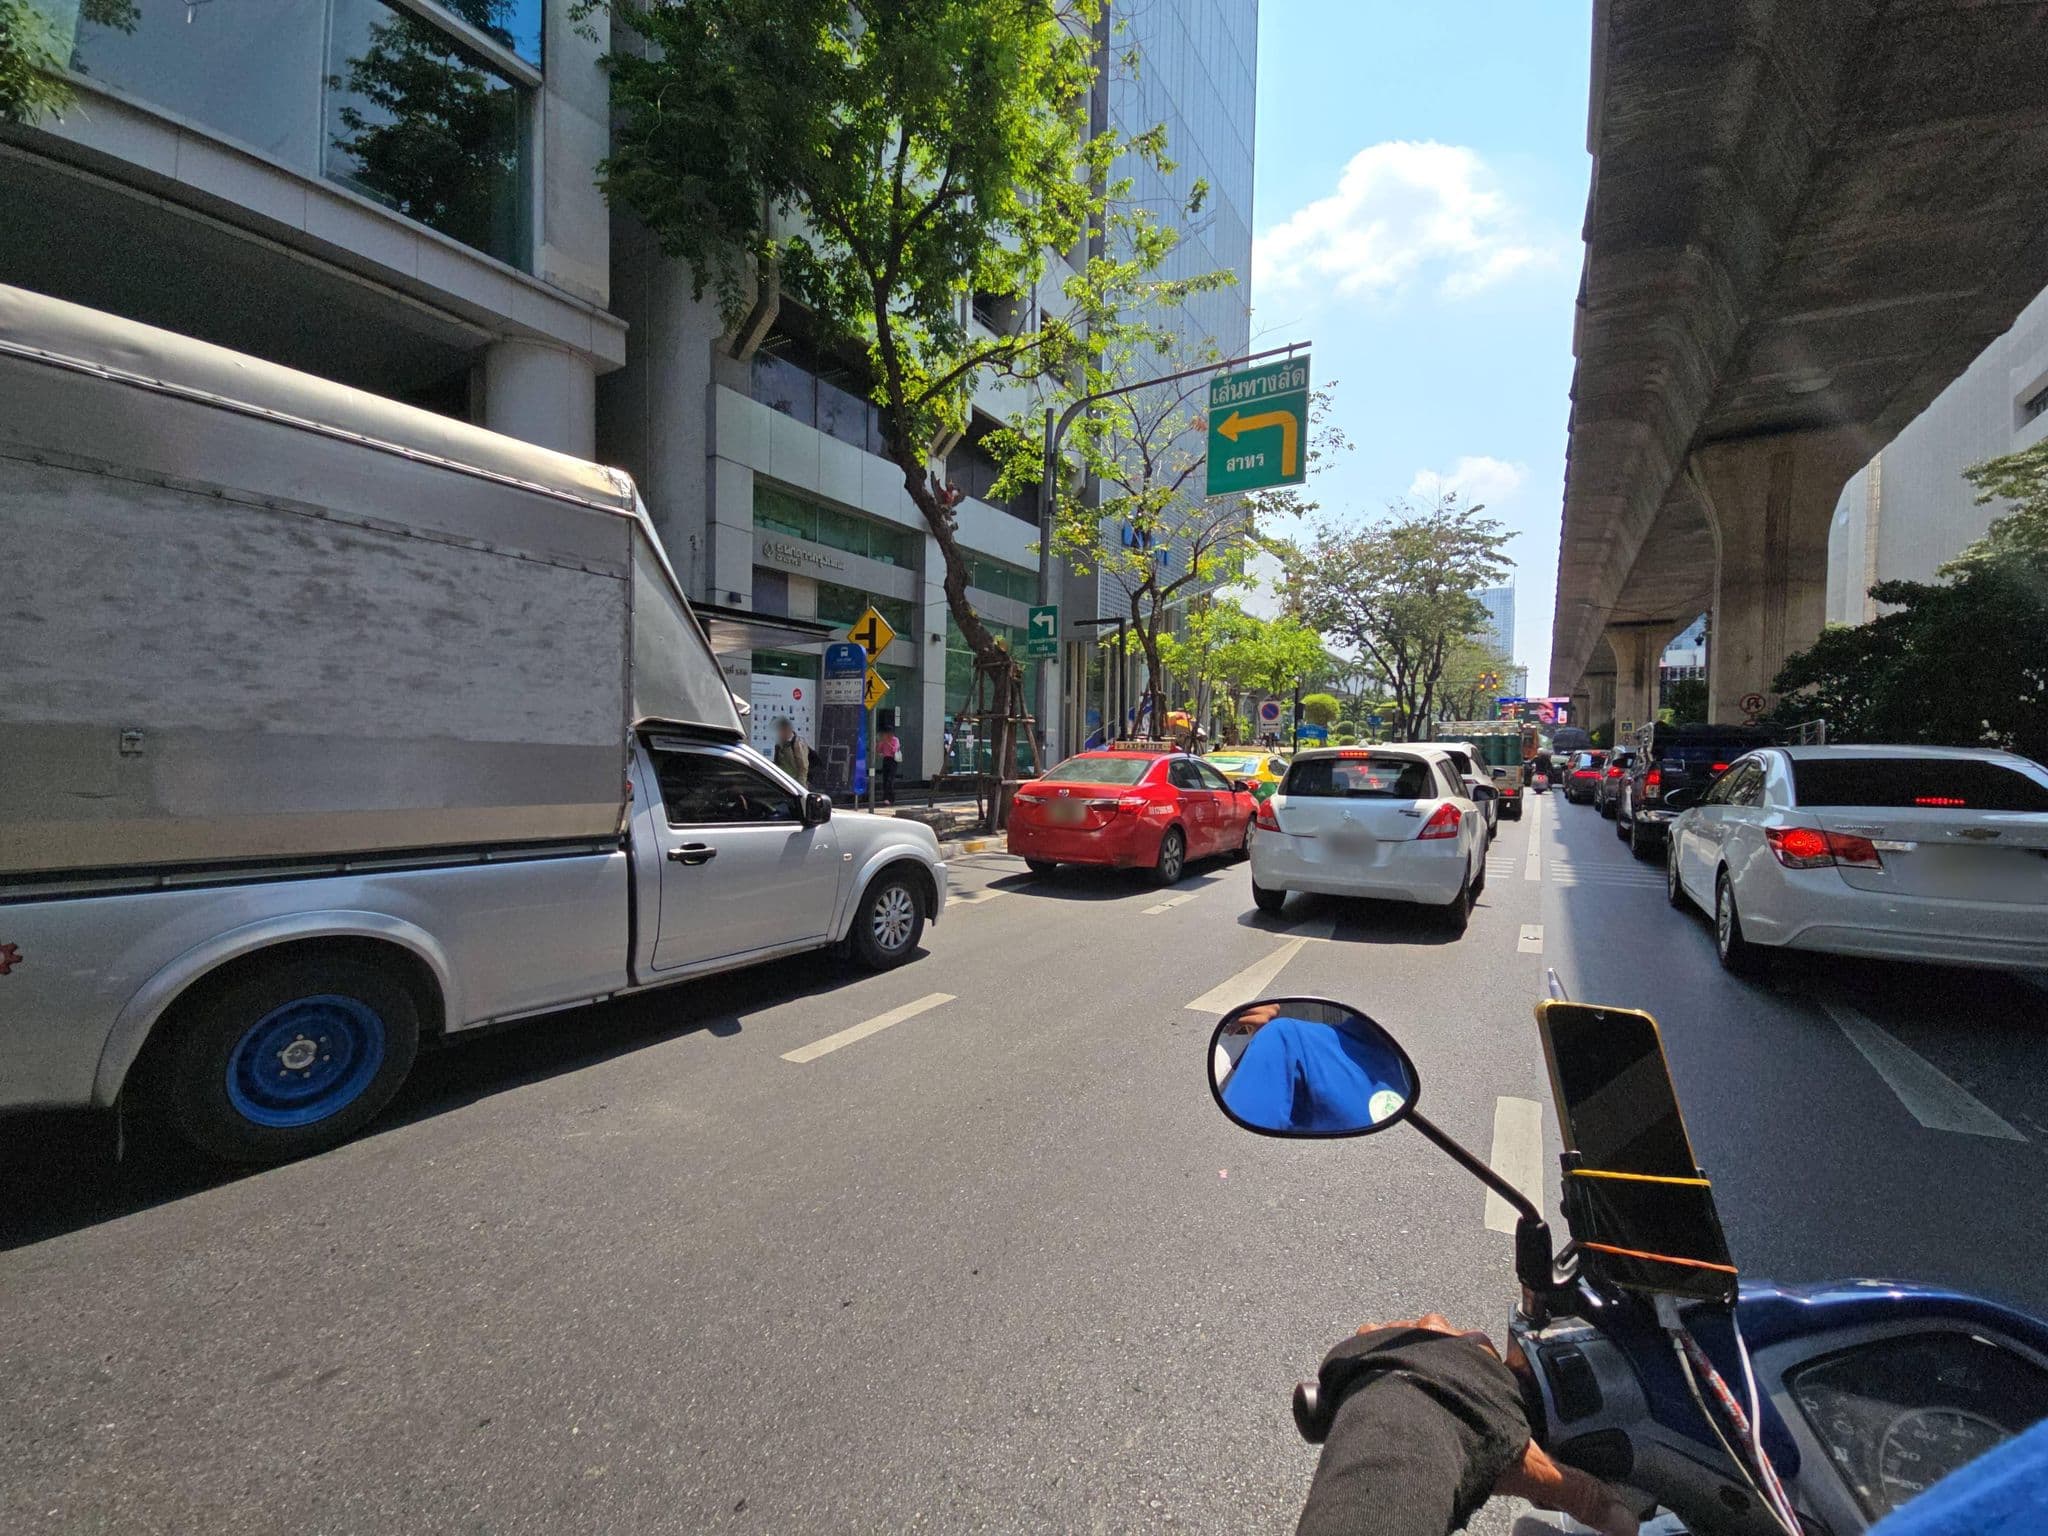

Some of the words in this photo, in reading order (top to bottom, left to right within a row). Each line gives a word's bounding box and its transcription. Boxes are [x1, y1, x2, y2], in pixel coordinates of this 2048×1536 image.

[1212, 364, 1305, 405] เส้นทางลัด
[1226, 452, 1266, 473] สาทร
[1895, 1450, 1921, 1462] 40
